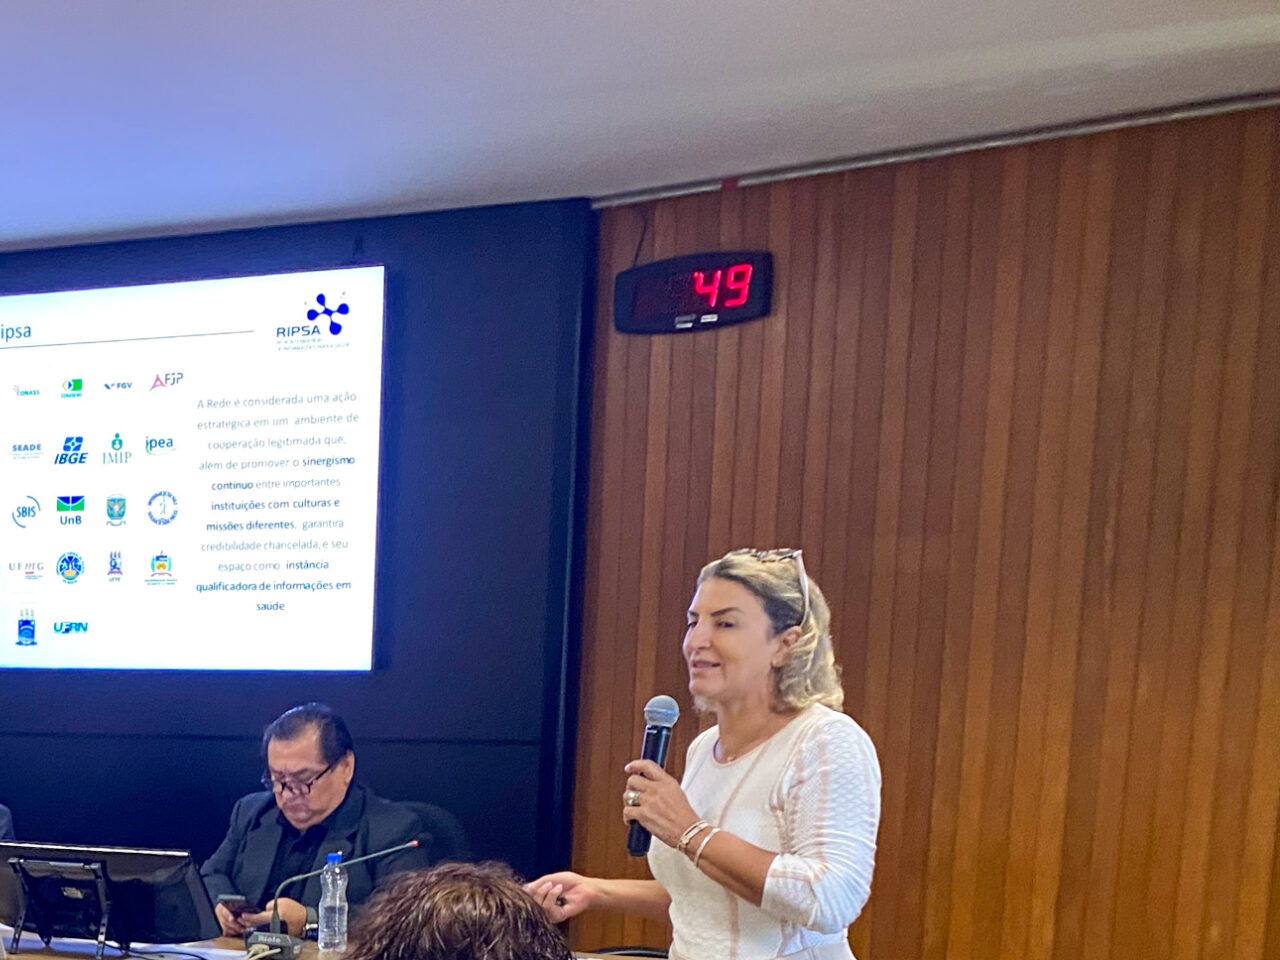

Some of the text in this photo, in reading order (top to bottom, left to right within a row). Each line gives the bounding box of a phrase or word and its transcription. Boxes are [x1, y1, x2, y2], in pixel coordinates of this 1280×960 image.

[693, 263, 753, 308] 49
[276, 325, 321, 337] RIPSA
[197, 400, 204, 409] A
[207, 399, 232, 409] Rede
[243, 394, 303, 407] considerada
[306, 394, 329, 403] uma
[332, 391, 357, 403] ação
[253, 420, 269, 428] em
[273, 418, 288, 426] um
[295, 414, 343, 425] ambiente
[346, 412, 359, 423] de
[12, 443, 42, 452] SEADE
[145, 436, 174, 450] ipea
[208, 438, 265, 451] cooperação
[54, 452, 89, 465] IBGE
[102, 452, 132, 464] IMIP
[226, 460, 238, 470] de
[241, 459, 289, 471] promover
[293, 459, 299, 467] o
[302, 455, 355, 467] sinergismo
[256, 480, 280, 489] entre
[283, 477, 341, 489] importantes
[211, 498, 340, 512] instituições com culturas e
[16, 506, 36, 518] SBIS
[60, 516, 82, 525] UnB
[206, 520, 244, 531] missões
[201, 540, 262, 551] credibilidade
[331, 540, 348, 549] seu
[218, 560, 329, 572] espaço como instância
[196, 581, 257, 593] qualificadora
[259, 581, 271, 590] de
[273, 580, 333, 592] informações
[256, 601, 285, 611] saúde
